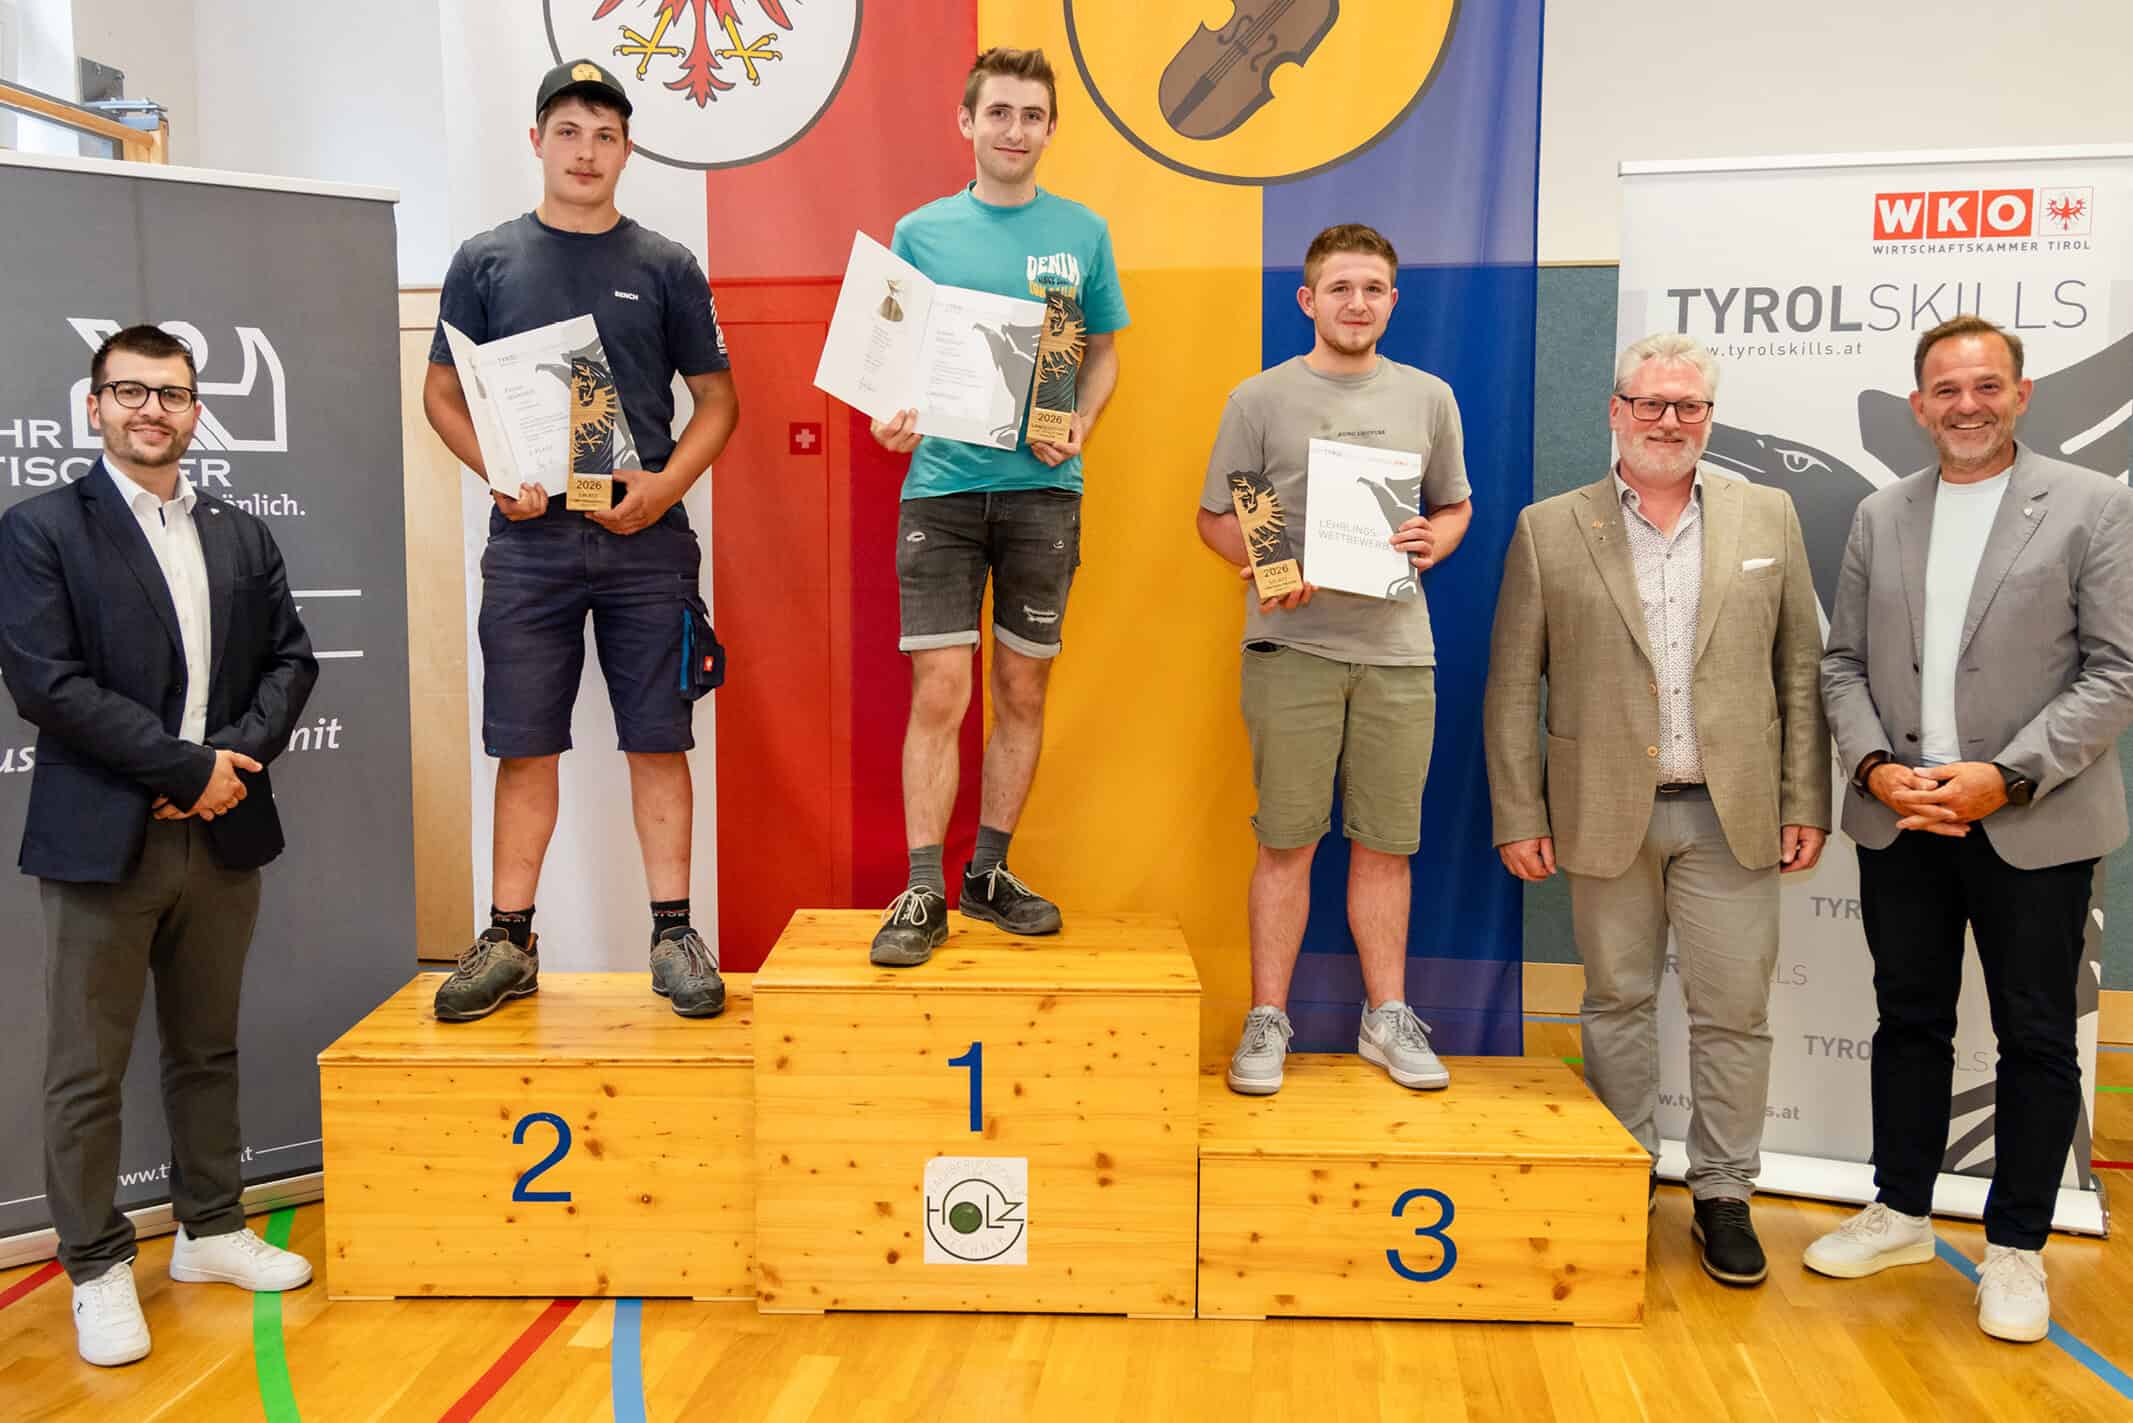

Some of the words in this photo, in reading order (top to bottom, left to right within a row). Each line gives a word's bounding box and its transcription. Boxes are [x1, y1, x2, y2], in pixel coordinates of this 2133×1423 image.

[1877, 194, 2027, 235] WKO
[1872, 242, 2039, 255] WIRTSCHAFTSKAMMER
[2048, 240, 2091, 251] TIROL
[1706, 341, 1863, 360] w.tyrolskills.at
[576, 479, 602, 490] 2026
[1263, 563, 1290, 578] 2026
[947, 1041, 983, 1132] 1
[512, 1112, 572, 1202] 2
[1386, 1188, 1457, 1283] 3
